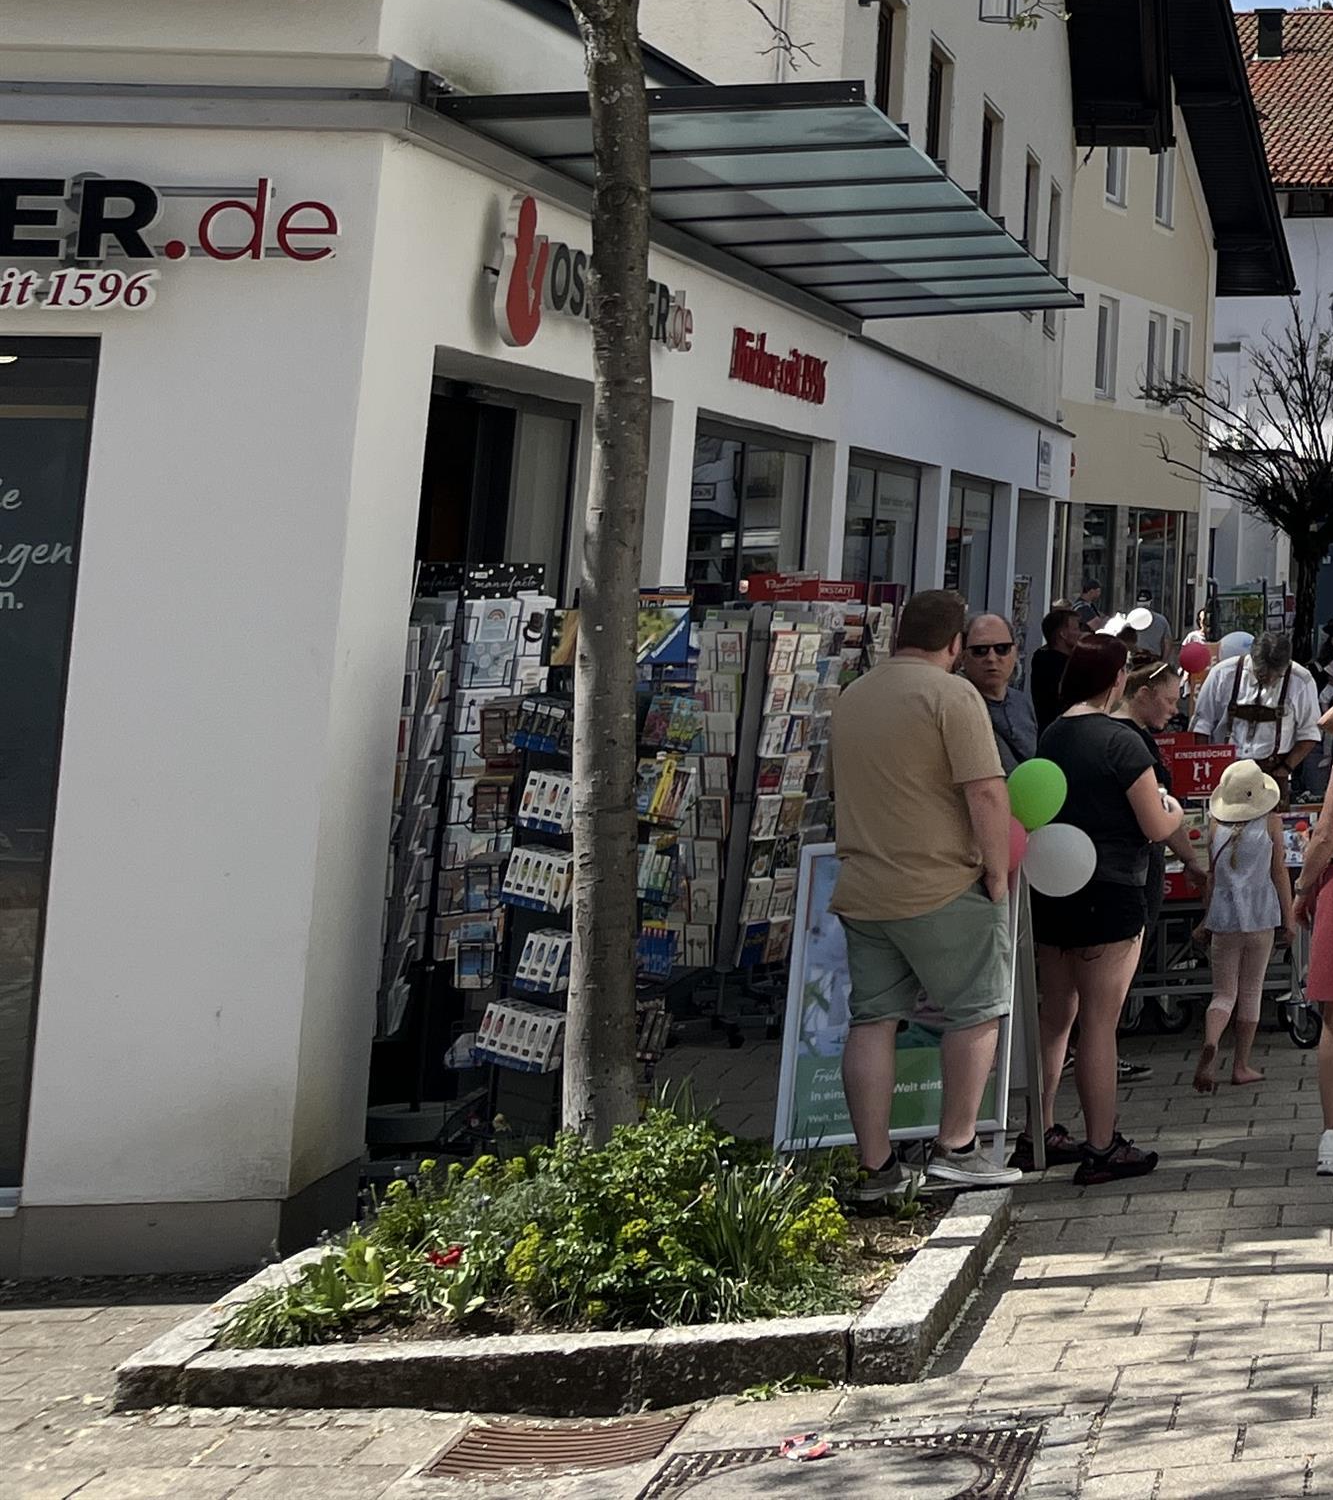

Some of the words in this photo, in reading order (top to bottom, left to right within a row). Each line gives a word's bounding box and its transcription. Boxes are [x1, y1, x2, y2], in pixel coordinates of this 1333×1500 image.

[46, 272, 154, 307] 1596
[0, 543, 73, 588] gen
[1174, 749, 1232, 760] KINDERBÜCHER
